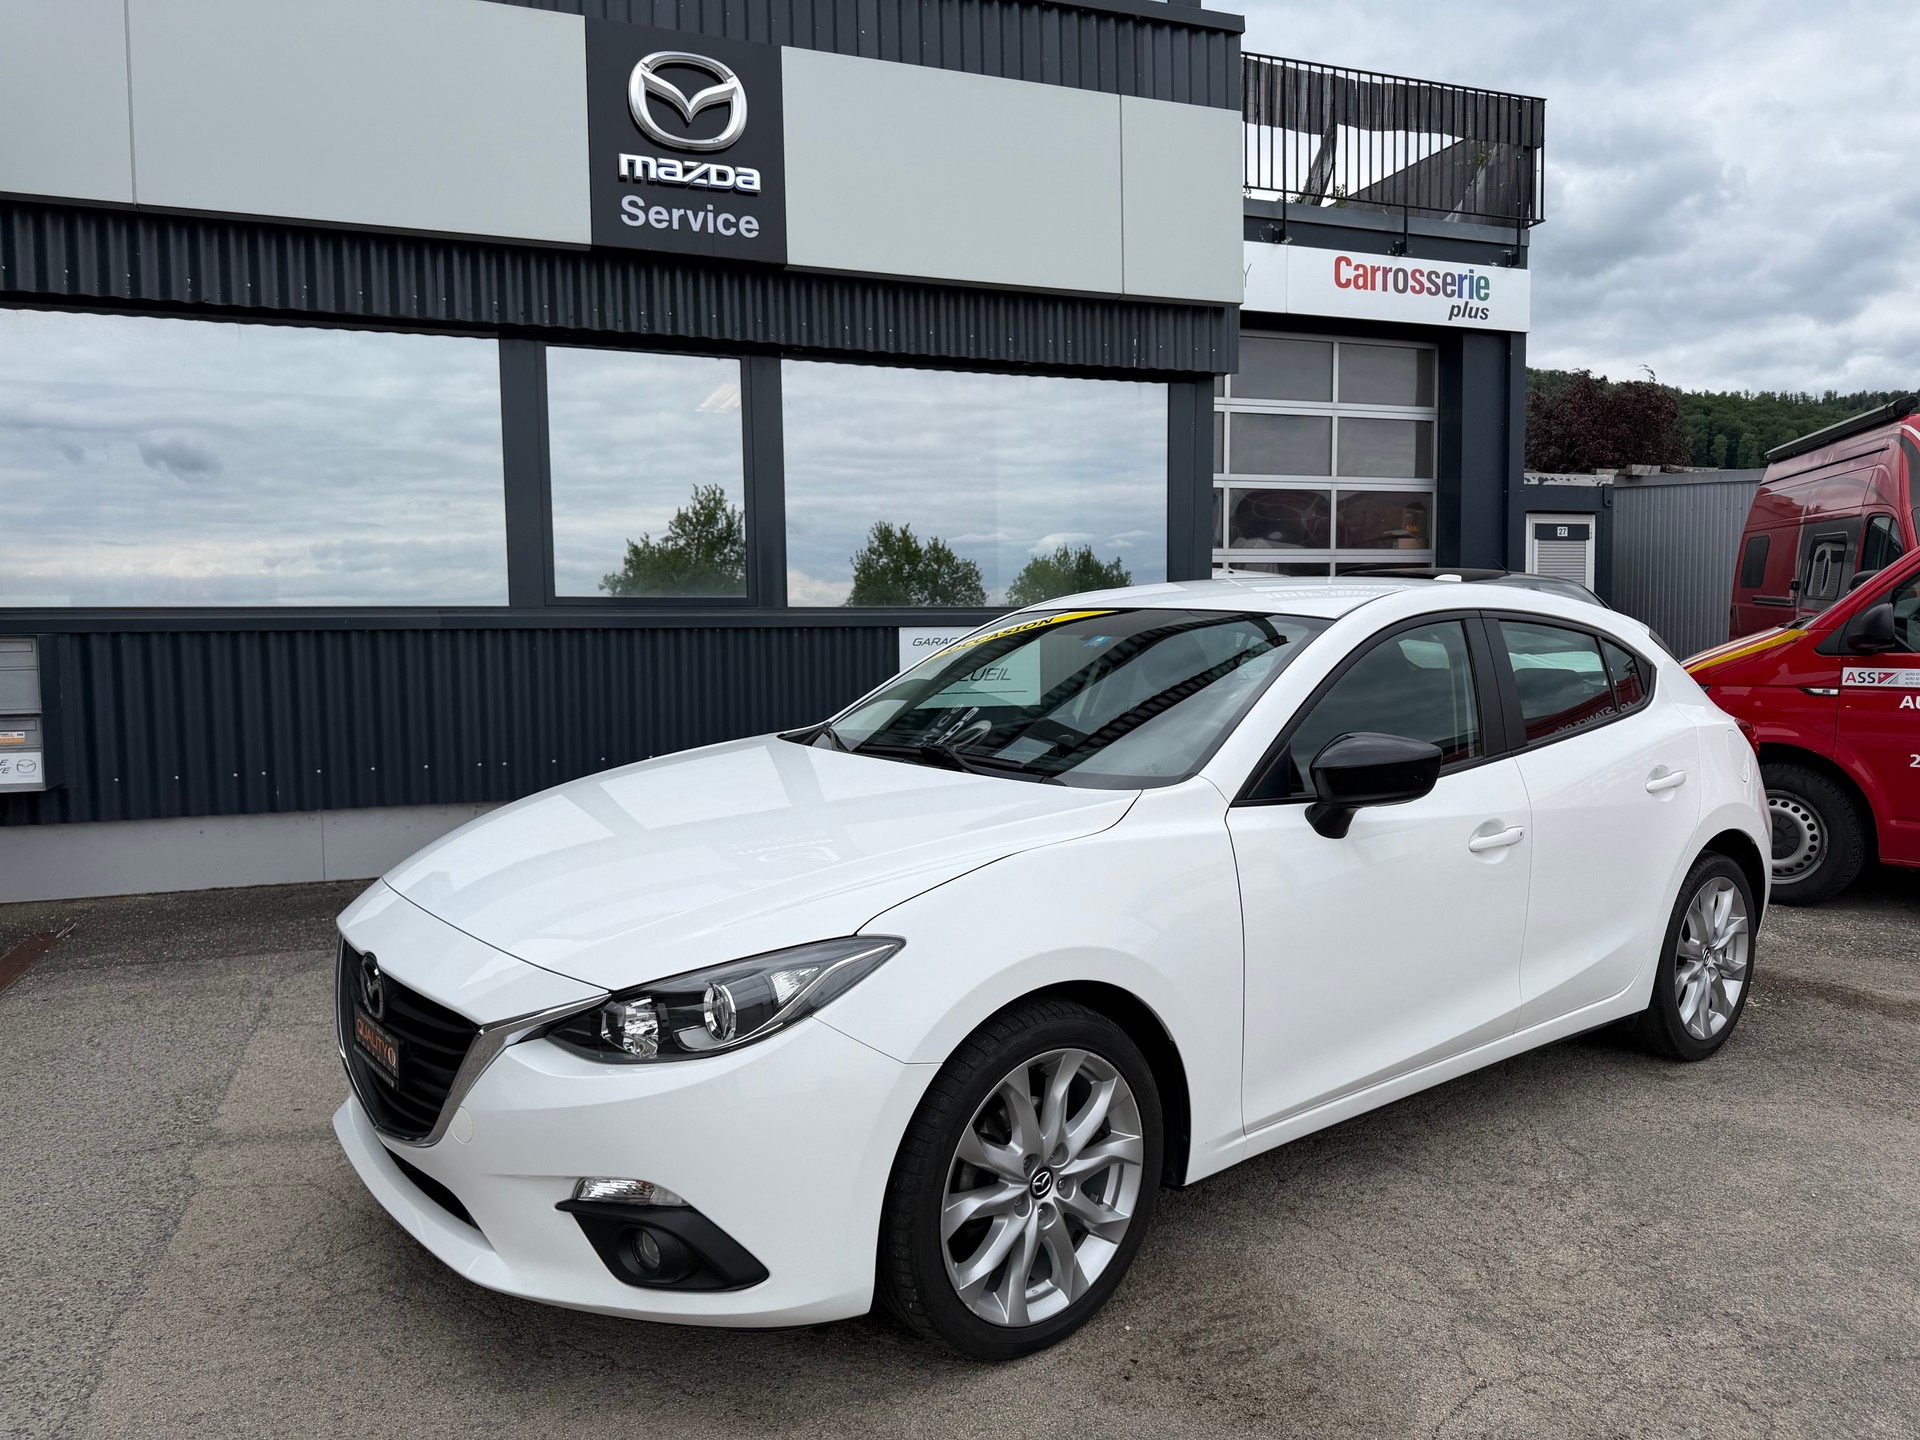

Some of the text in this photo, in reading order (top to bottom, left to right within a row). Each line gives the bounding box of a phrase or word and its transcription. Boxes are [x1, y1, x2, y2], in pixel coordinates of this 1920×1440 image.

[620, 195, 760, 238] Service
[1334, 255, 1490, 301] Carrosserie
[1448, 301, 1490, 321] plus
[1845, 671, 1876, 684] ASS
